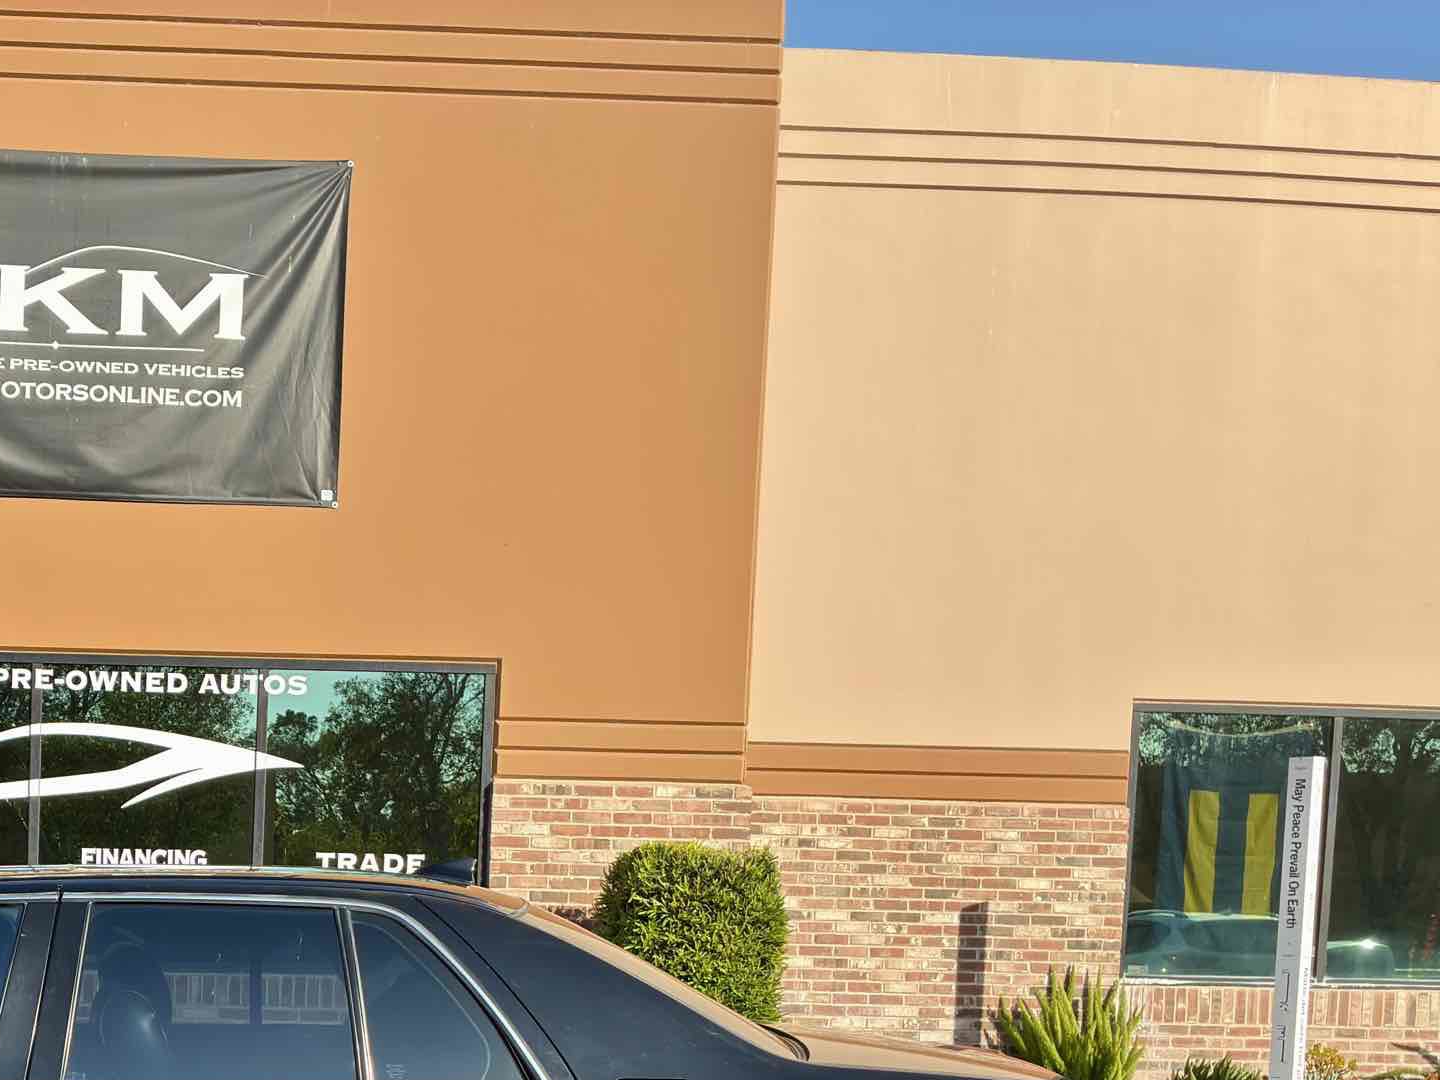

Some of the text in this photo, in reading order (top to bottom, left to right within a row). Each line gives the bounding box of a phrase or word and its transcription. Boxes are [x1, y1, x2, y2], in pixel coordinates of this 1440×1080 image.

[10, 358, 139, 374] PRE-OWNED
[144, 363, 245, 379] VEHICLES
[198, 673, 308, 696] AUTOS
[81, 847, 208, 866] FINANCING
[316, 851, 426, 874] TRADE
[1286, 778, 1307, 929] May Peace Prevail On Earth
